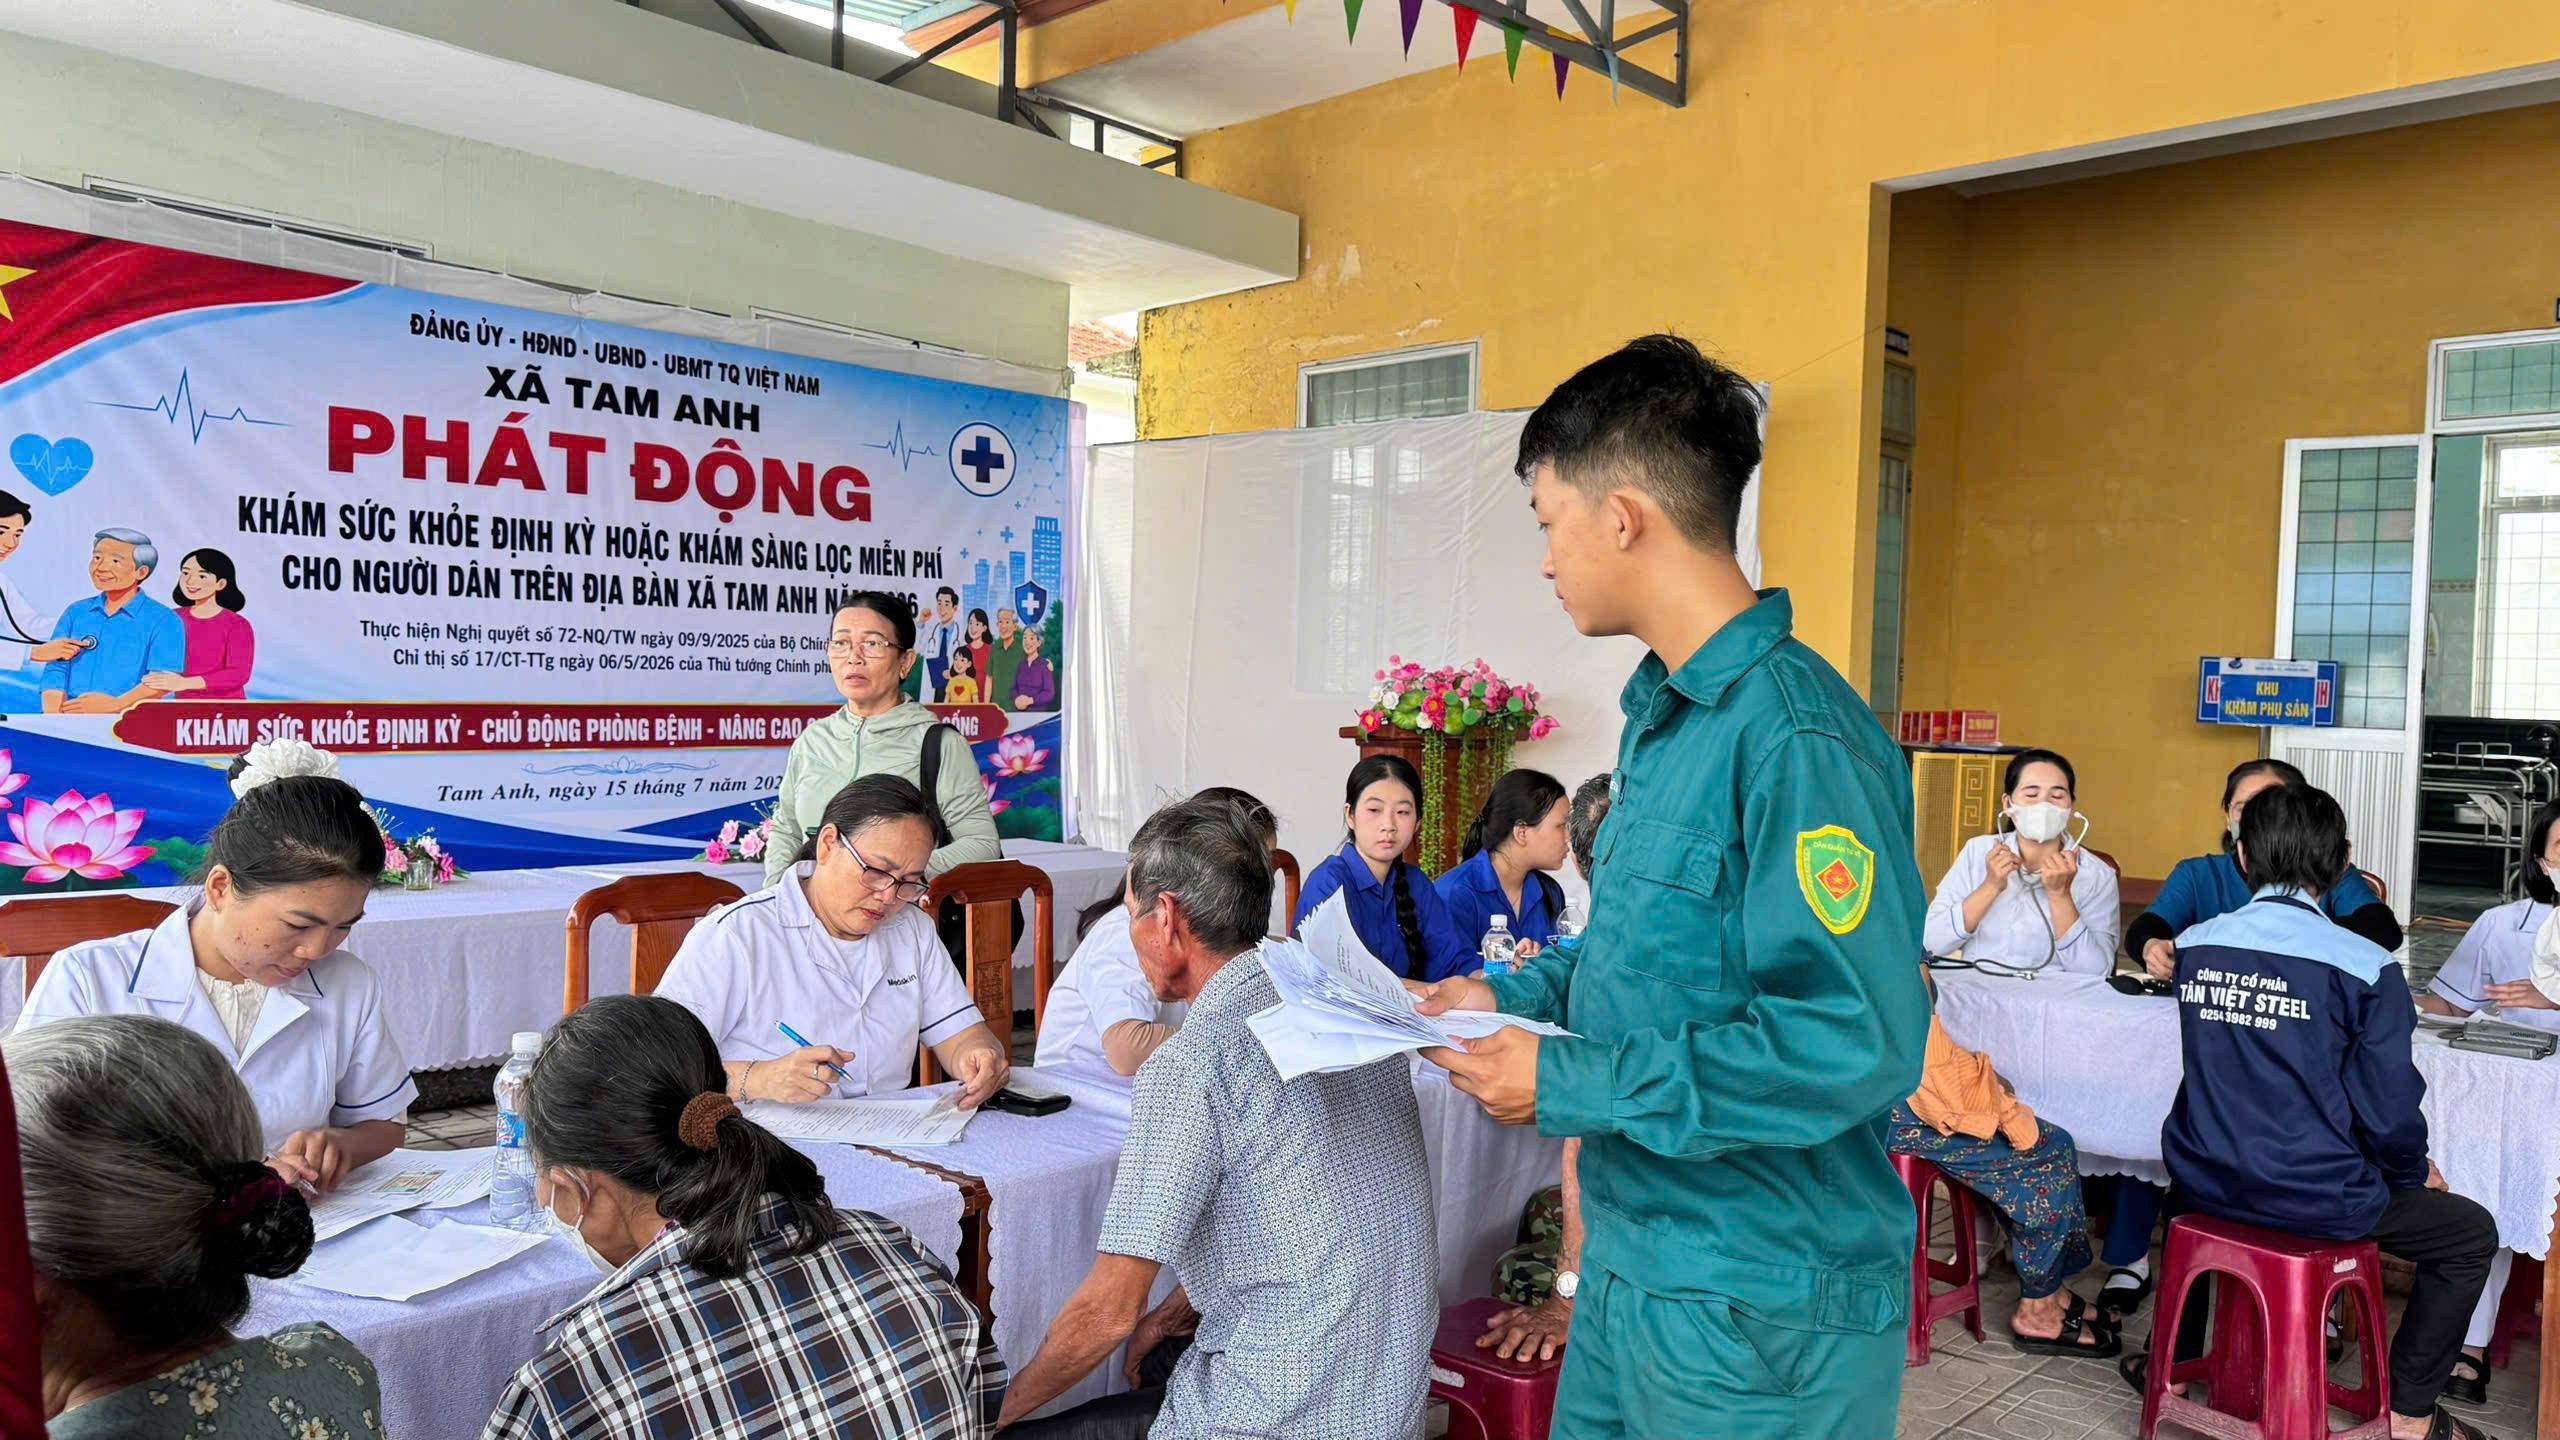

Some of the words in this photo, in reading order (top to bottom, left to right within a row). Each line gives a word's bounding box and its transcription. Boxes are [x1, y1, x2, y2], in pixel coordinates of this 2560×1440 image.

[410, 312, 470, 344] ĐẢNG
[476, 316, 503, 348] ỦY
[522, 332, 576, 358] HĐND
[595, 343, 646, 370] UBND
[664, 353, 713, 380] UBMT
[718, 362, 740, 386] TQ
[745, 366, 780, 394] VIỆT
[785, 372, 820, 397] NAM
[484, 363, 550, 405] XÃ
[565, 377, 659, 419] TAM
[674, 394, 760, 432] ANH
[328, 405, 606, 495] PHÁT
[629, 437, 872, 523] ĐỘNG
[238, 491, 326, 537] KHÁM
[339, 499, 396, 542] SỨC
[409, 502, 479, 548] KHỎE
[491, 516, 553, 558] ĐỊNH
[565, 517, 595, 556] KỲ
[606, 522, 669, 567] HOẶC
[679, 528, 743, 566] KHÁM
[752, 532, 808, 571] SÀNG
[816, 543, 852, 579] LỌC
[860, 539, 905, 577] MIỄN
[912, 546, 943, 579] PHÍ
[282, 554, 341, 591] CHO
[353, 557, 437, 596] NGƯỜI
[448, 560, 501, 599] DÂN
[511, 564, 573, 602] TRÊN
[583, 573, 624, 612] ĐỊA
[633, 571, 679, 607] BÀN
[688, 575, 717, 610] XÃ
[724, 582, 768, 612] TAM
[776, 585, 817, 615] ANH
[360, 620, 400, 641] Thực
[407, 622, 440, 642] hiện
[446, 624, 482, 643] Nghị
[488, 625, 530, 644] quyết
[535, 626, 554, 642] số
[558, 627, 636, 646] 72-NQ/TW
[641, 631, 673, 649] ngày
[678, 631, 750, 649] 09/9/2025
[753, 634, 776, 650] của
[780, 635, 797, 652] Bộ
[393, 648, 419, 665] Chỉ
[425, 649, 445, 669] thị
[451, 650, 469, 666] số
[475, 651, 554, 671] 17/CT-TTg
[560, 653, 594, 672] ngày
[599, 653, 675, 671] 06/5/2026
[679, 654, 703, 671] của
[708, 656, 731, 672] Thủ
[735, 657, 772, 676] tướng
[776, 658, 811, 673] Chính
[2256, 681, 2279, 695] KHU
[2225, 698, 2257, 715] KHÁM
[2259, 702, 2282, 719] PHỤ
[2285, 699, 2309, 718] SẢN
[176, 713, 249, 746] KHÁM
[256, 713, 304, 745] SỨC
[311, 710, 369, 745] KHỎE
[376, 718, 428, 750] ĐỊNH
[434, 713, 461, 744] KỲ
[482, 711, 522, 743] CHỦ
[527, 714, 580, 748] ĐỘNG
[586, 711, 649, 743] PHÒNG
[655, 711, 702, 746] BỆNH
[719, 713, 766, 740] NÂNG
[770, 718, 802, 739] CAO
[438, 785, 483, 801] Tam
[491, 783, 541, 801] Anh,
[549, 781, 597, 801] ngày
[606, 780, 627, 796] 15
[633, 778, 687, 797] tháng
[694, 778, 704, 793] 7
[710, 779, 747, 792] năm
[2197, 968, 2222, 982] CÔNG
[2225, 973, 2239, 984] TY
[2179, 980, 2205, 1003] TÂN
[2210, 985, 2251, 1013] VIỆT
[2254, 993, 2311, 1020] STEEL
[2225, 1011, 2252, 1026] 3982
[2254, 1018, 2277, 1031] 999
